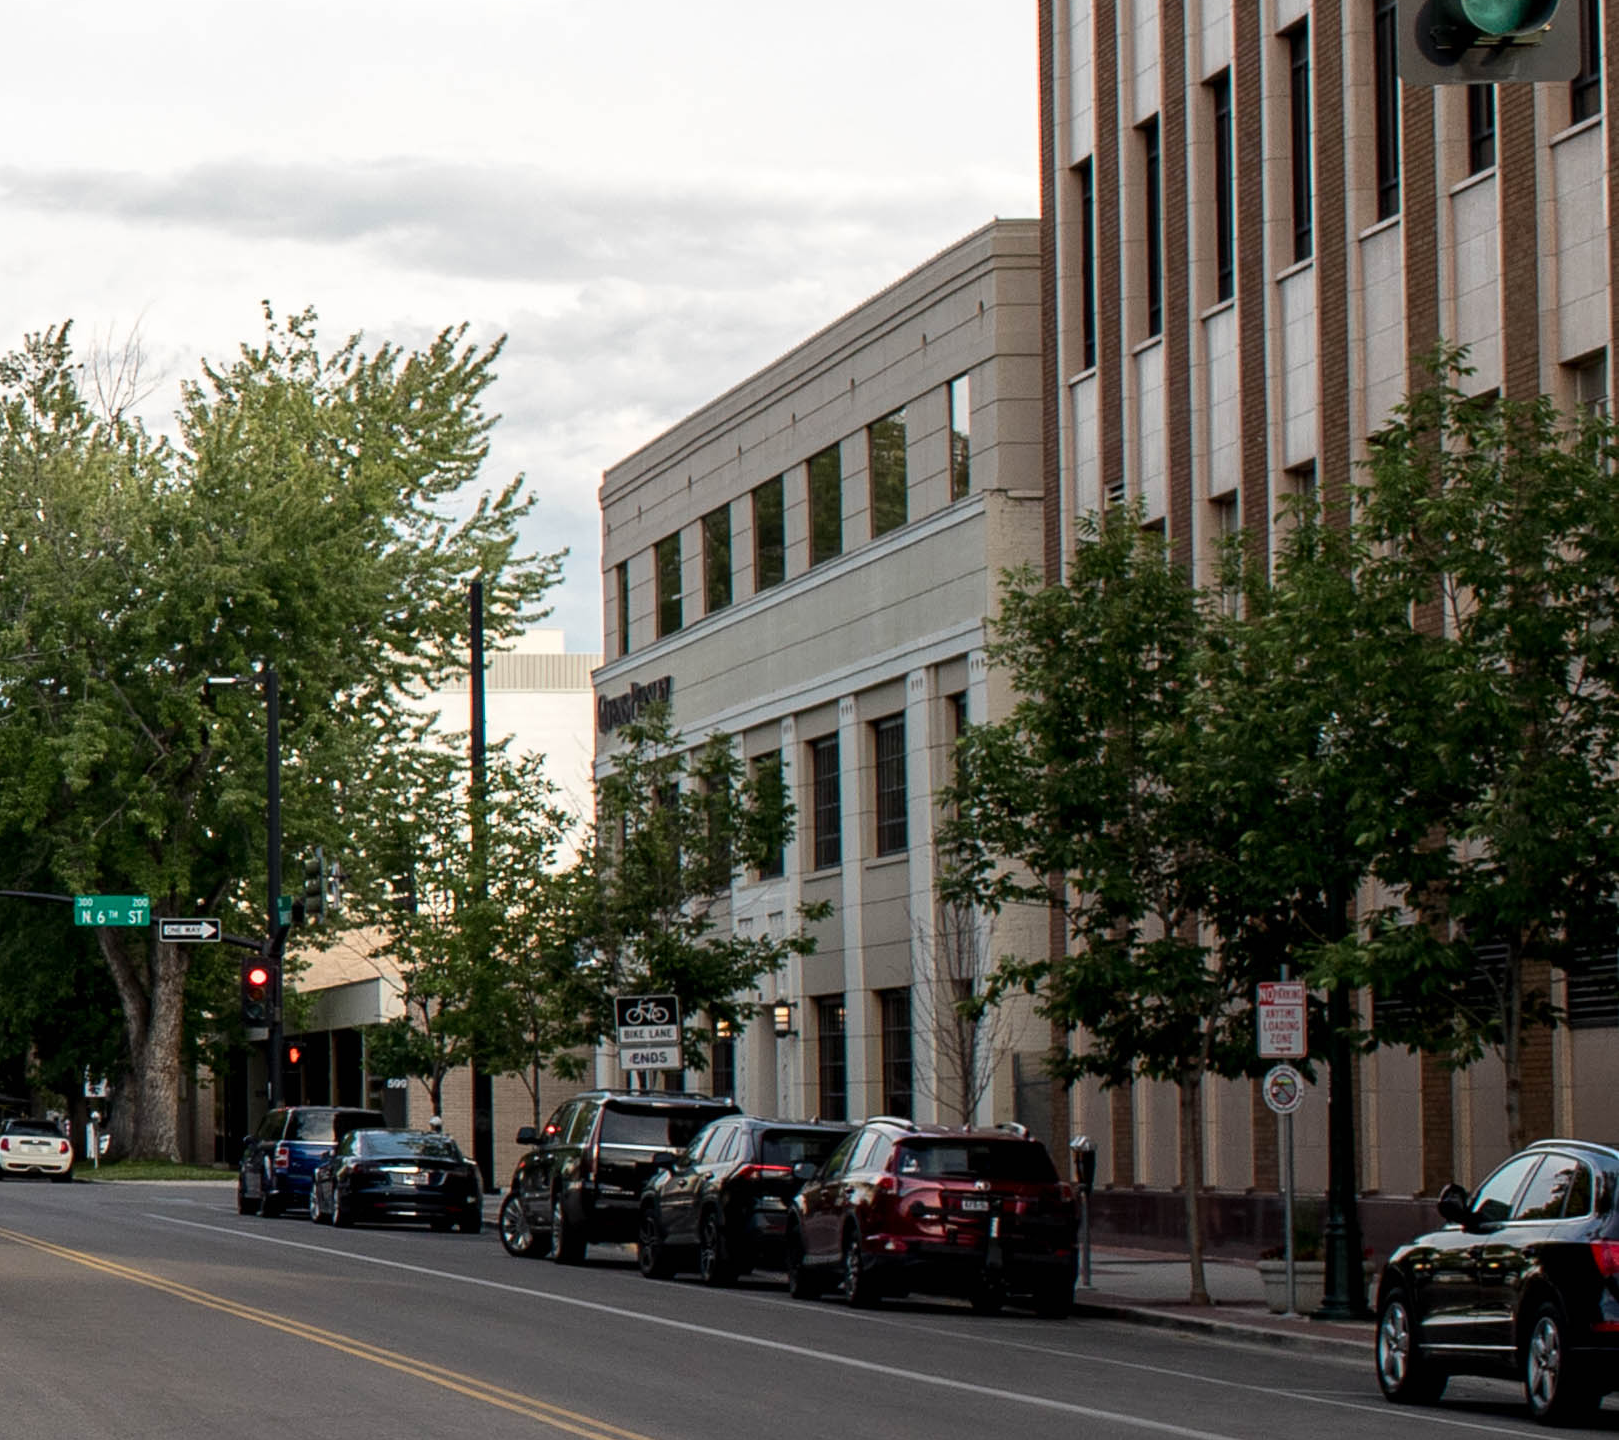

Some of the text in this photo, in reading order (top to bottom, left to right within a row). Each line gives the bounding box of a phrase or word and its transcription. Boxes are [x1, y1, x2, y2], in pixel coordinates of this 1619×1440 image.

[77, 897, 149, 907] 300 200
[128, 910, 143, 924] ST
[1259, 987, 1274, 1002] NO
[1265, 1008, 1296, 1018] ANYTIME
[1263, 1021, 1300, 1032] LOADING
[624, 1029, 672, 1039] BIKE LANE
[1269, 1033, 1293, 1044] ZONE
[632, 1052, 668, 1064] ENDS
